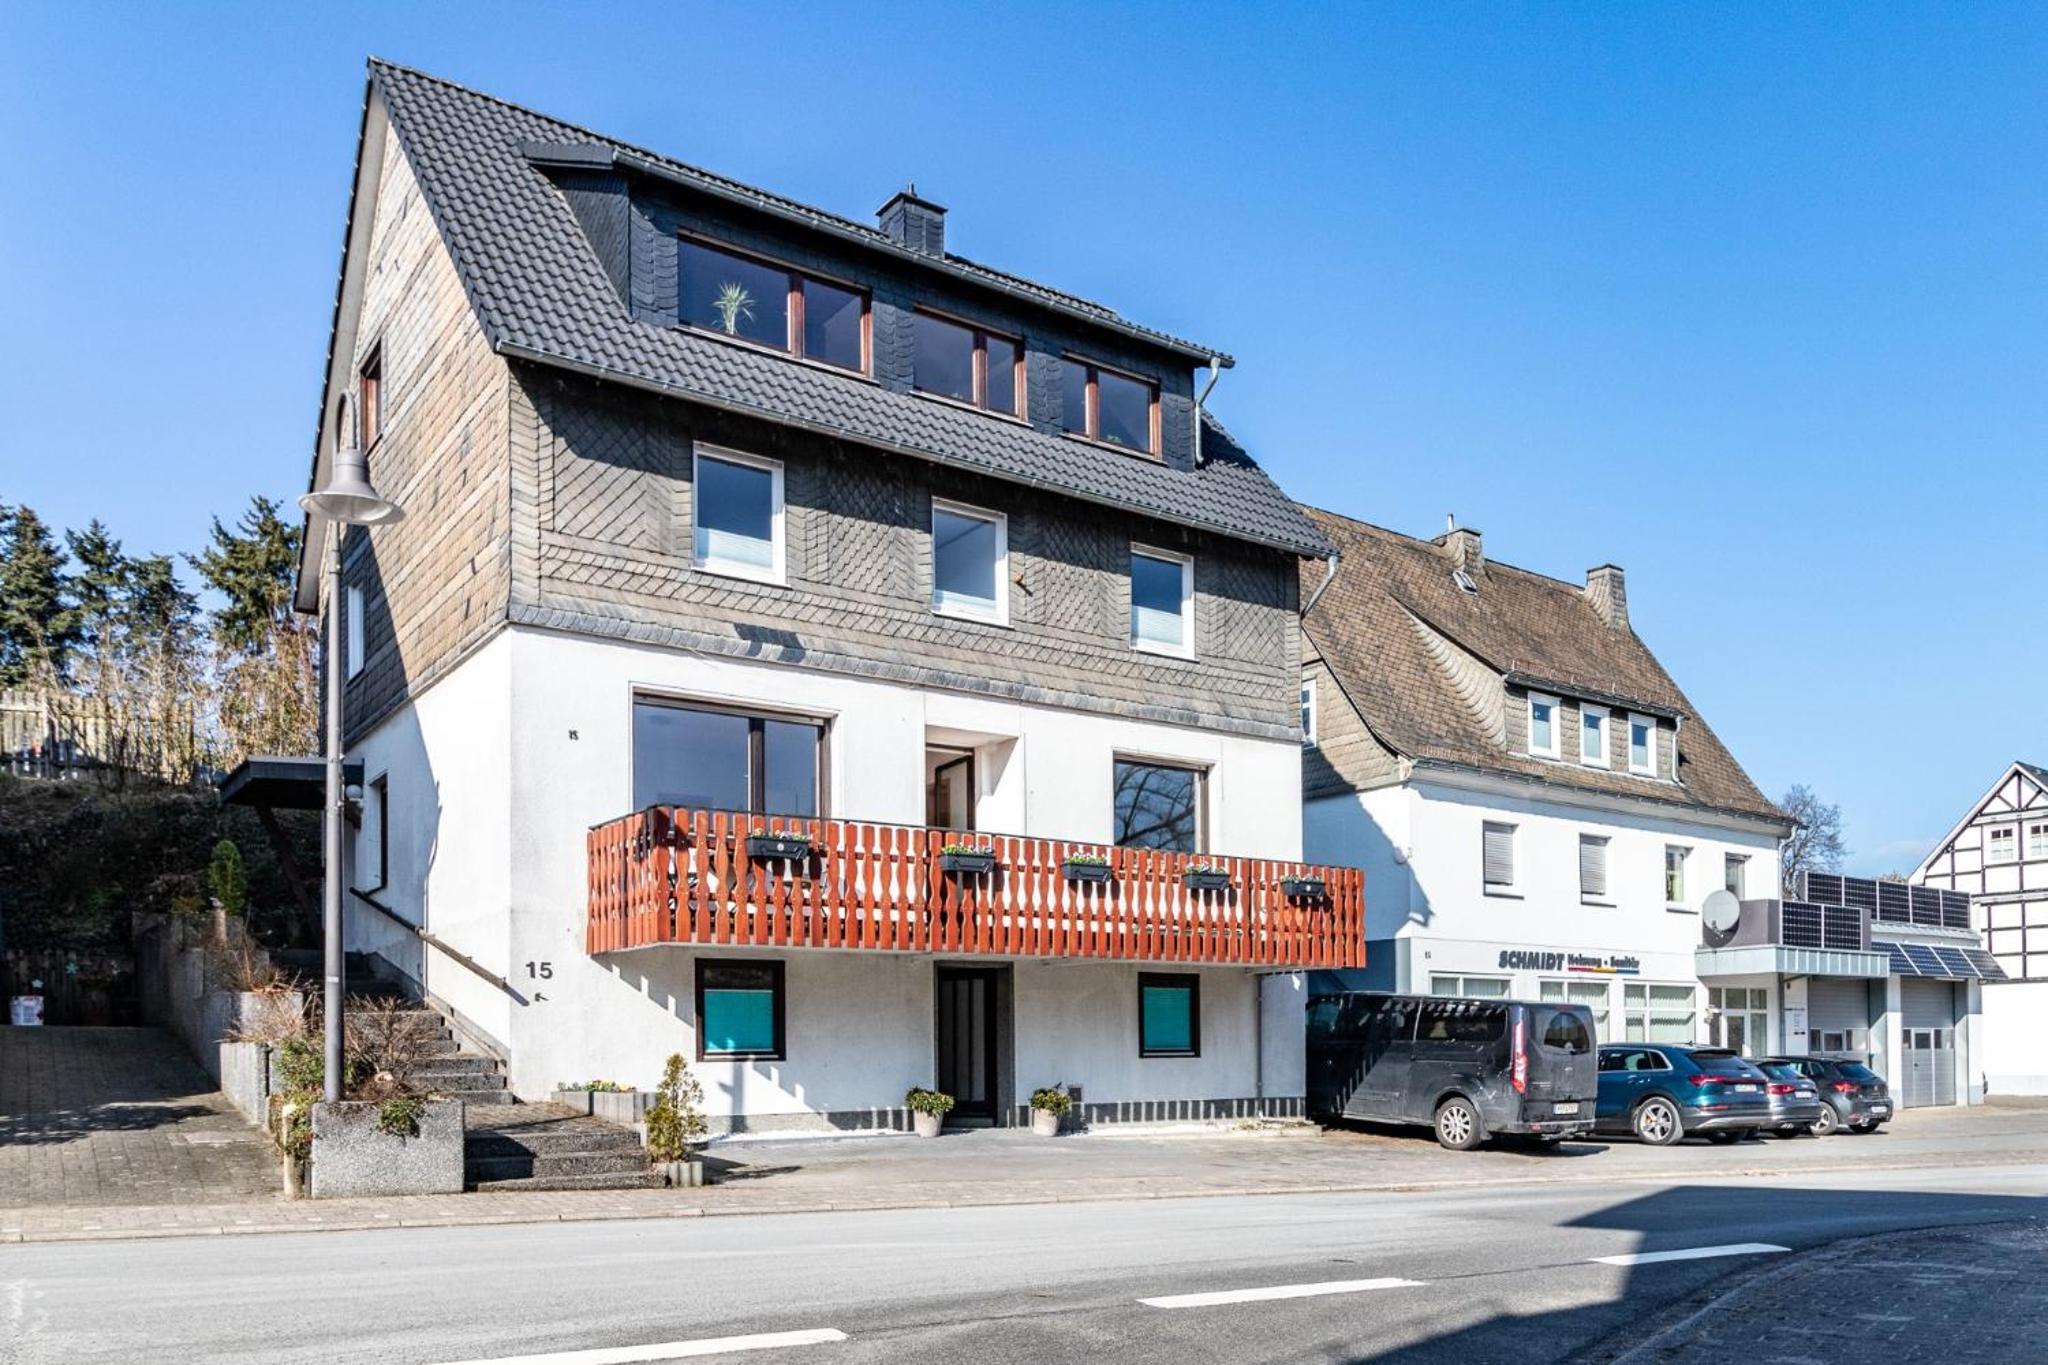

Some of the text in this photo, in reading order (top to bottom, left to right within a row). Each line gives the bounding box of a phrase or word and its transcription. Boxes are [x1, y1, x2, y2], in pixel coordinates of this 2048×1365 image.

[568, 729, 579, 741] 15
[1499, 950, 1565, 971] SCHMIDT
[525, 961, 553, 979] 15
